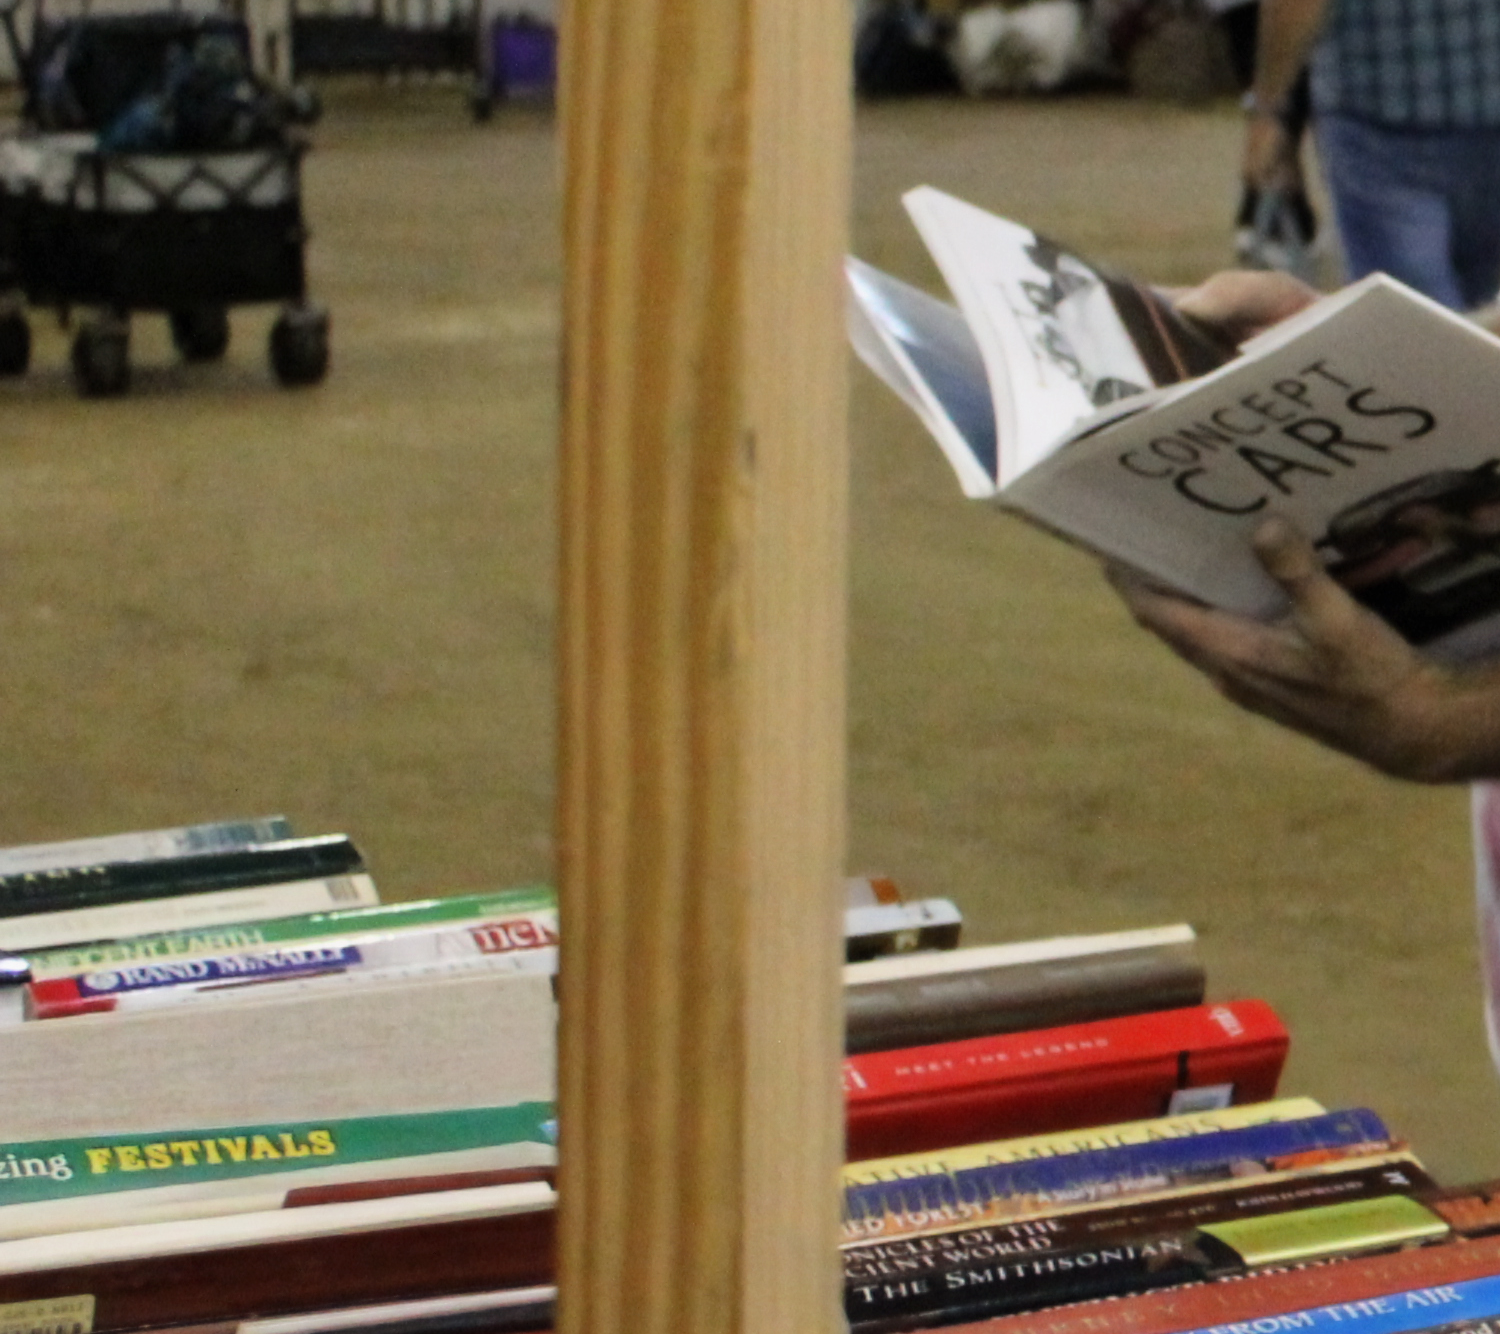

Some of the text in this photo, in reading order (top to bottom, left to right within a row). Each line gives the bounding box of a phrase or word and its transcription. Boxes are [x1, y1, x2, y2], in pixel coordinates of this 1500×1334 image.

[1119, 360, 1351, 479] CONCEPT
[1174, 388, 1436, 516] CARS
[85, 1130, 336, 1175] FESTIVALS
[942, 1234, 1054, 1268] WORLD
[852, 1279, 929, 1303] THE
[1311, 1295, 1396, 1322] THE
[1405, 1284, 1464, 1310] AIR
